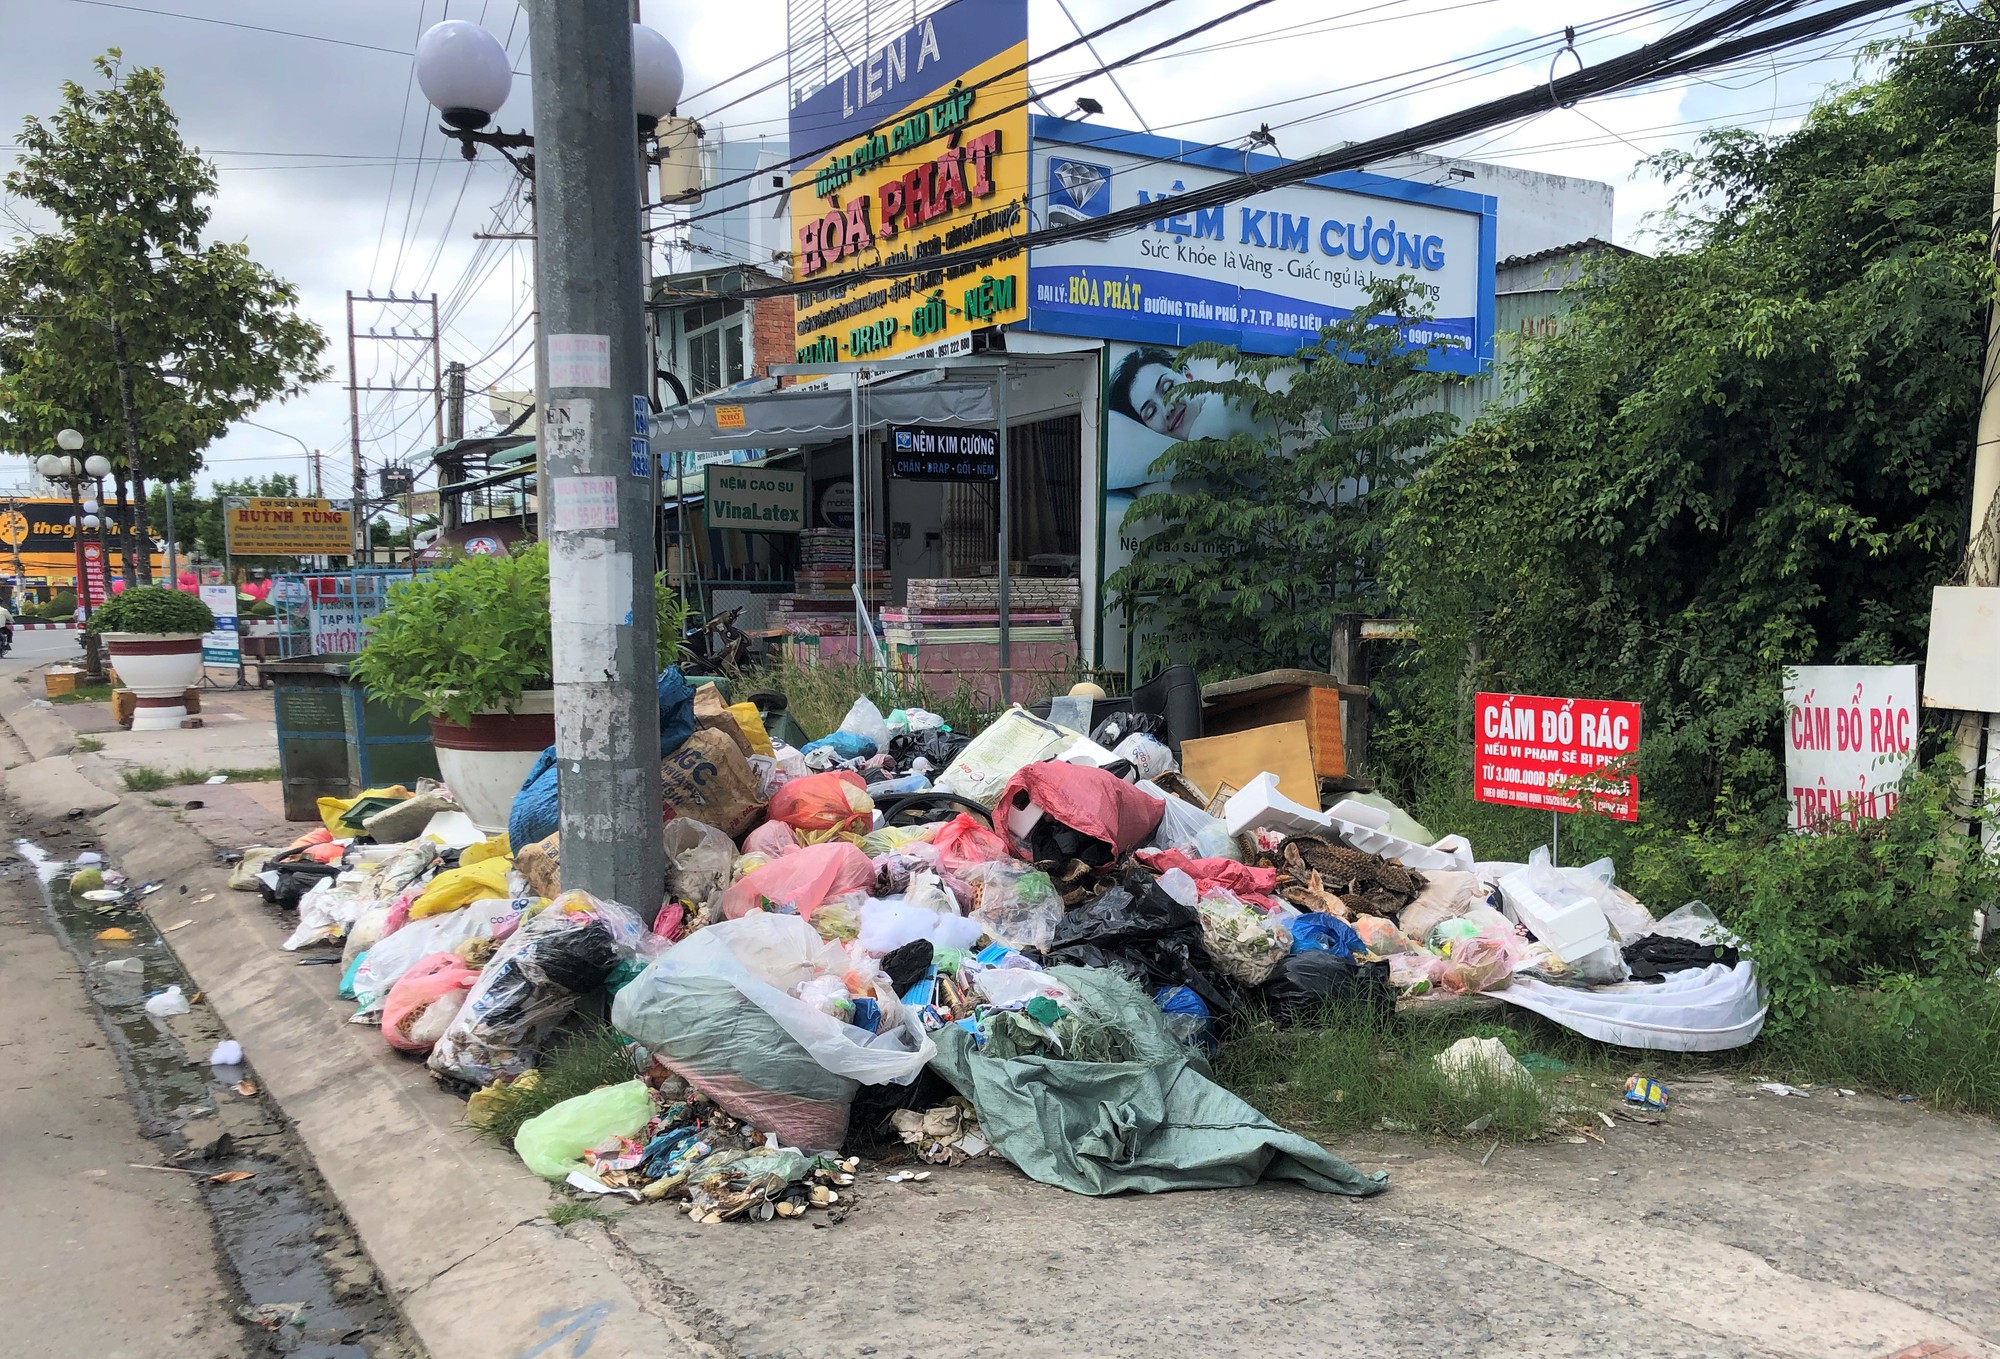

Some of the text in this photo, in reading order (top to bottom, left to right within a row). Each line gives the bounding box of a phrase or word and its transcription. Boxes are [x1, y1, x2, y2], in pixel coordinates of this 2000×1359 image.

[815, 156, 851, 198] MÀN
[890, 113, 929, 152] CAO
[932, 80, 976, 132] CẤP
[800, 130, 1002, 277] HÒA PHÁT
[1140, 239, 1170, 259] Sức
[1177, 245, 1217, 266] Khỏe
[1224, 251, 1236, 269] là
[1239, 253, 1273, 279] Vàng
[1287, 259, 1320, 280] Giấc
[1324, 267, 1350, 288] ngủ
[1354, 270, 1365, 287] là
[1239, 207, 1310, 254] KIM
[1319, 215, 1446, 271] CƯƠNG
[850, 318, 898, 357] DRAP
[911, 289, 947, 338] GỐI
[964, 275, 1016, 322] NỆM
[1037, 284, 1053, 304] ĐẠI
[1054, 284, 1068, 303] LÝ:
[1069, 269, 1100, 306] HÒA
[1103, 274, 1142, 311] PHÁT
[1144, 296, 1183, 317] ĐƯỜNG
[1185, 299, 1213, 320] TRẦN
[1215, 305, 1239, 325] PHÚ,
[1241, 308, 1258, 326] P.7,
[1260, 310, 1275, 327] TP.
[1277, 312, 1298, 331] BẠC
[1300, 313, 1322, 331] LIÊU
[913, 430, 995, 456] NỆM KIM CƯƠNG
[720, 476, 794, 492] NỆM CAO SU
[238, 508, 342, 523] HUỲNH TÙNG
[714, 500, 800, 522] VinaLatex
[321, 615, 343, 626] TẠP
[1484, 697, 1629, 750] CẤM ĐỔ RÁC
[1791, 682, 1910, 754] CẤM ĐỔ RÁC
[1482, 763, 1494, 780] TỪ
[1496, 767, 1545, 787] 3.000.000Đ
[1484, 742, 1507, 756] NẾU
[1510, 746, 1521, 757] VI
[1524, 748, 1558, 763] PHẠM
[1562, 750, 1577, 764] SẼ
[1580, 754, 1593, 767] BỊ
[1483, 787, 1496, 798] THEO
[1509, 790, 1516, 800] 20
[1793, 776, 1842, 831] TRÊN
